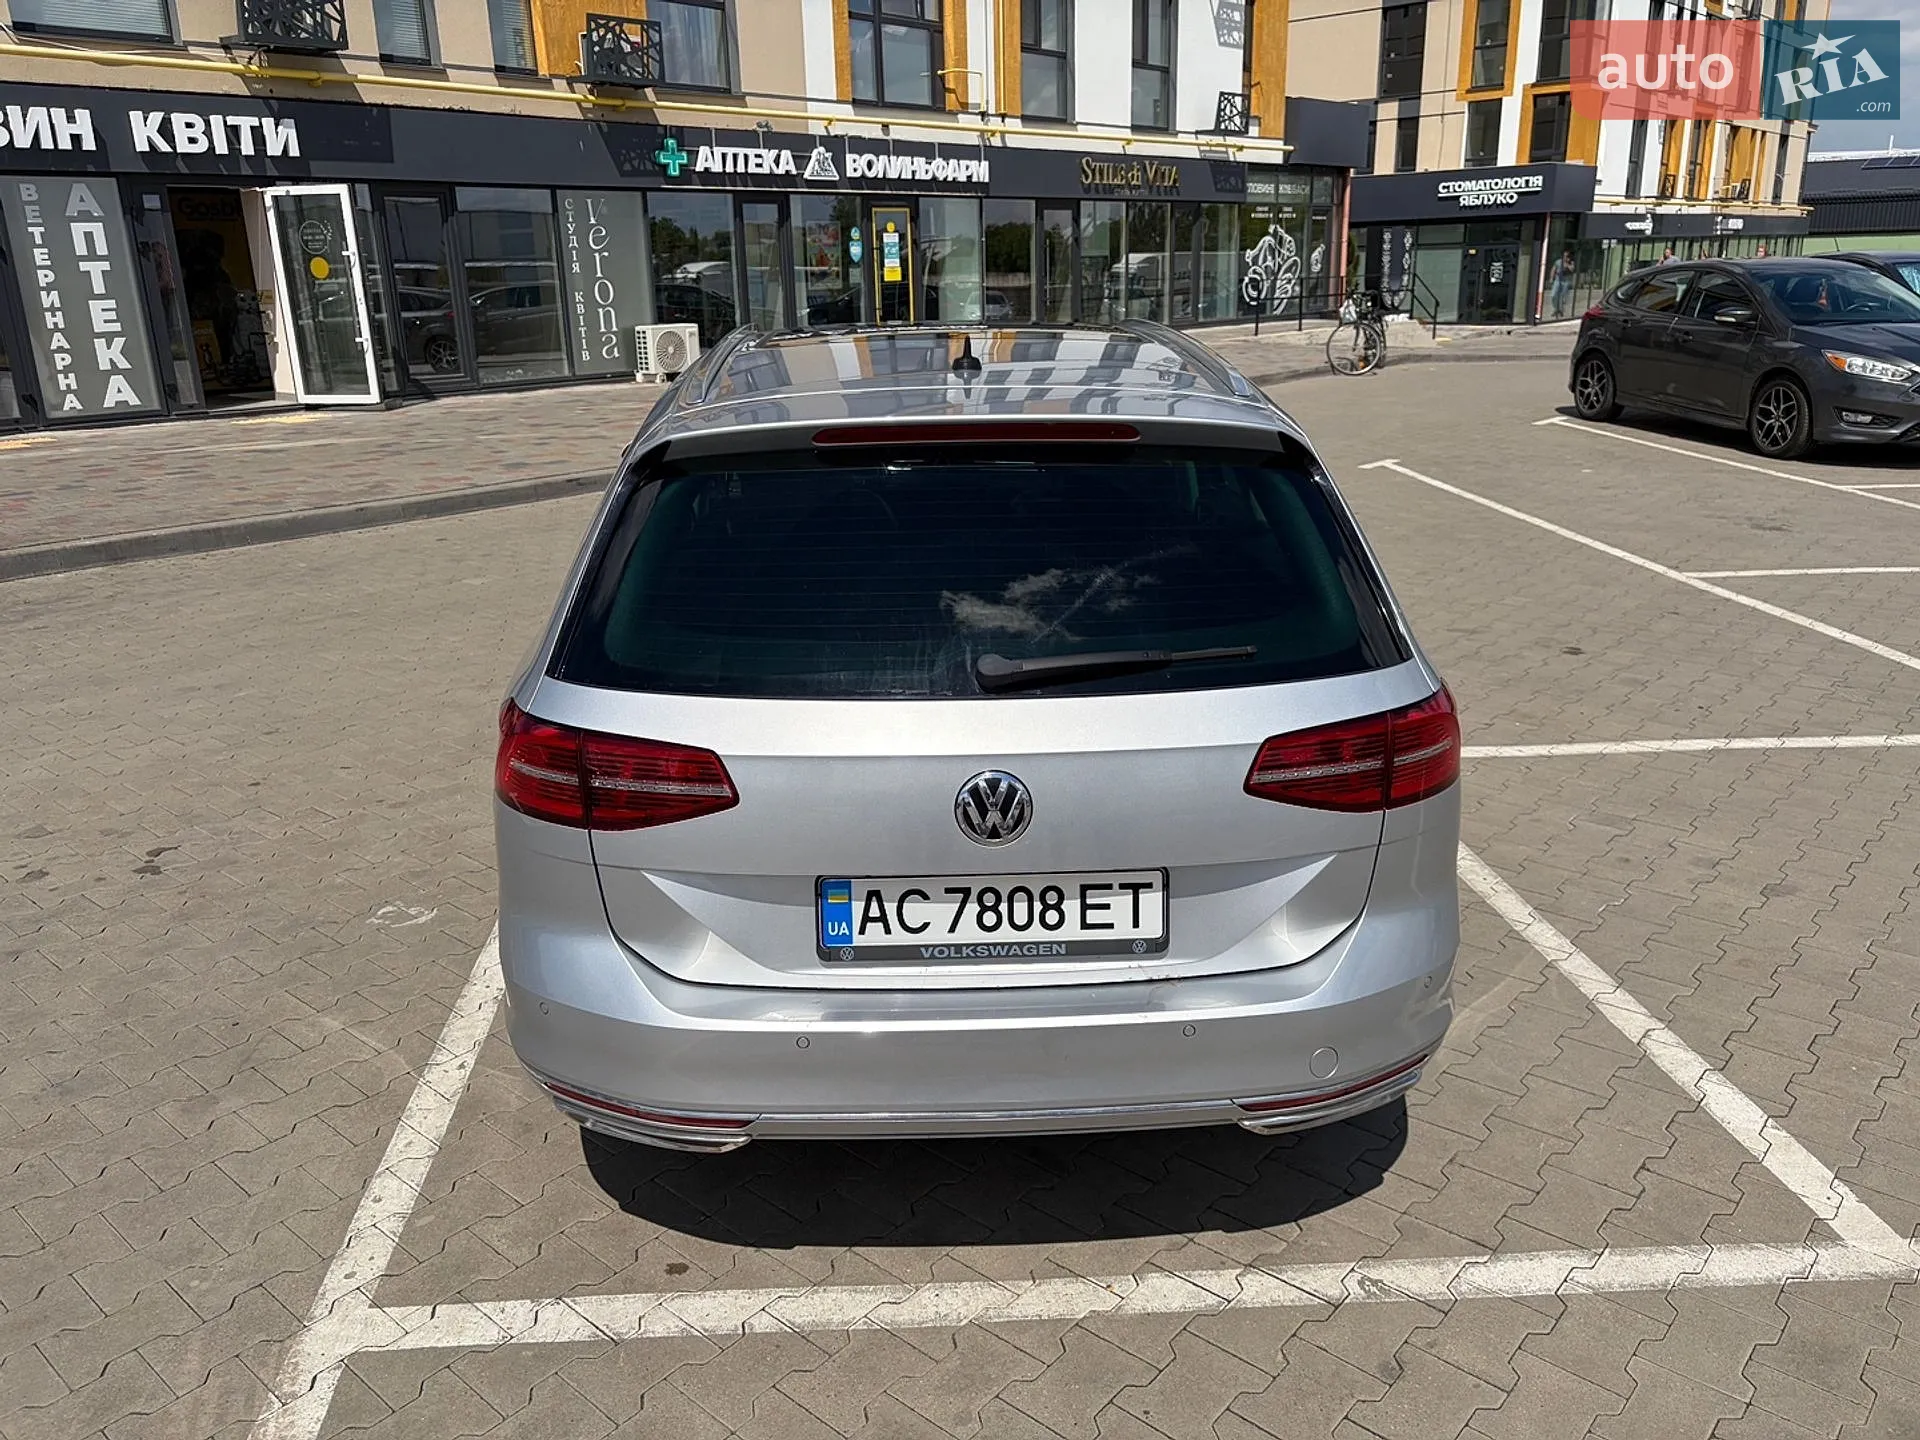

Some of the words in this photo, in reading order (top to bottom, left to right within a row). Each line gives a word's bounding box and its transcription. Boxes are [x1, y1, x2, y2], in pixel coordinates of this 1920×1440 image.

[0, 105, 97, 152] ИН
[128, 110, 301, 157] КВІТИ
[694, 146, 797, 176] АПТЕКА
[845, 153, 990, 183] ВОЛИНЬФАРМ
[1438, 175, 1543, 193] СТОМАТОЛОГІЯ
[1459, 192, 1519, 207] ЯБЛУКО
[18, 183, 84, 411] ВЕТЕРИНАРНА
[64, 183, 142, 408] АПТЕКА
[565, 198, 581, 273] СТУДІЯ
[574, 291, 590, 361] КВІТІВ
[585, 198, 620, 359] Verona
[828, 921, 850, 937] UA
[858, 888, 931, 936] AC
[943, 884, 1067, 934] 7808
[1079, 881, 1155, 931] ET
[920, 942, 1067, 959] VOLKSWAGEN
